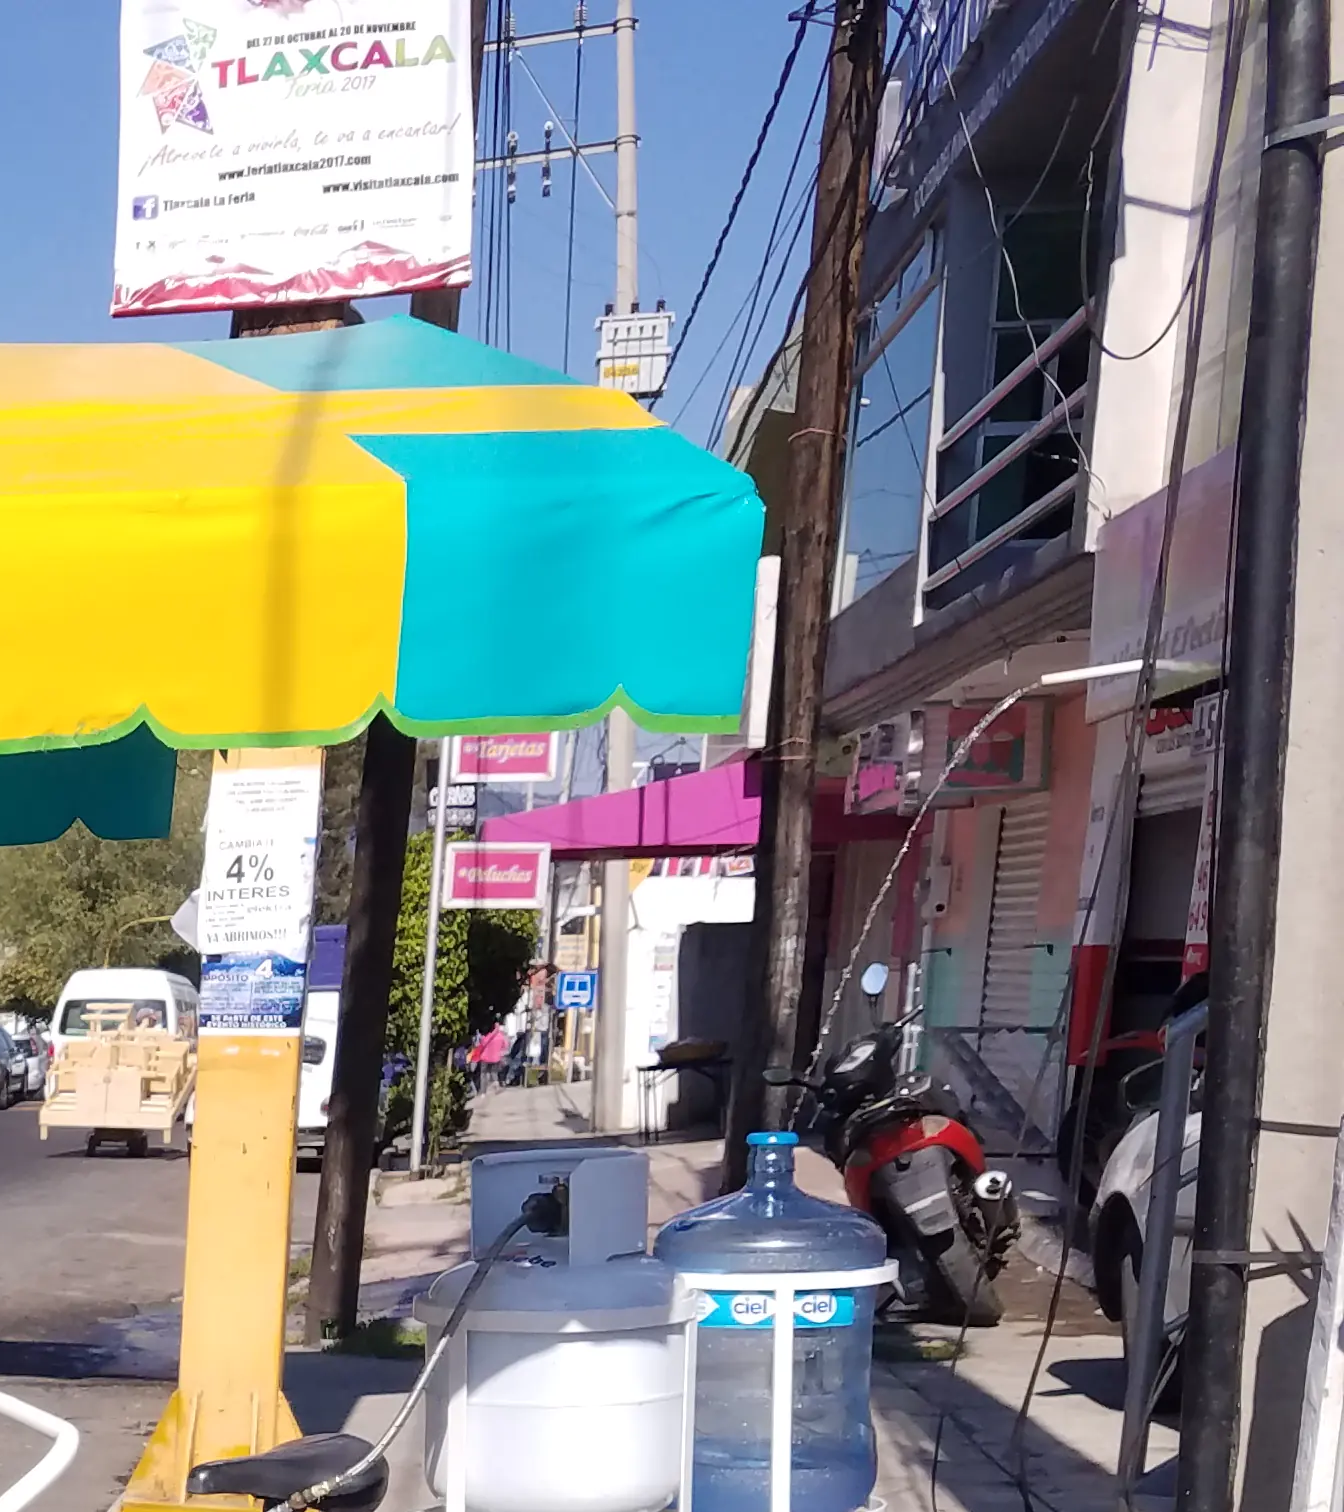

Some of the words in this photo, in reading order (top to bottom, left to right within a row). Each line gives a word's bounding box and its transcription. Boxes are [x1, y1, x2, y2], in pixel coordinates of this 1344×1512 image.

[246, 38, 260, 49] DEL
[262, 36, 273, 47] 27
[274, 34, 286, 45] DE
[287, 29, 327, 44] OCTUBRE
[328, 27, 339, 39] AL
[353, 24, 365, 36] DE
[366, 20, 417, 34] NOVIEMBRE
[211, 34, 455, 88] TLAXCALA
[340, 75, 377, 92] 2017
[322, 172, 460, 194] www.visitatlaxcala.com
[477, 739, 547, 763] Tarjetas
[226, 853, 274, 884] 4%
[207, 885, 290, 902] INTERES
[733, 1297, 768, 1315] ciel
[801, 1296, 833, 1314] ciel
